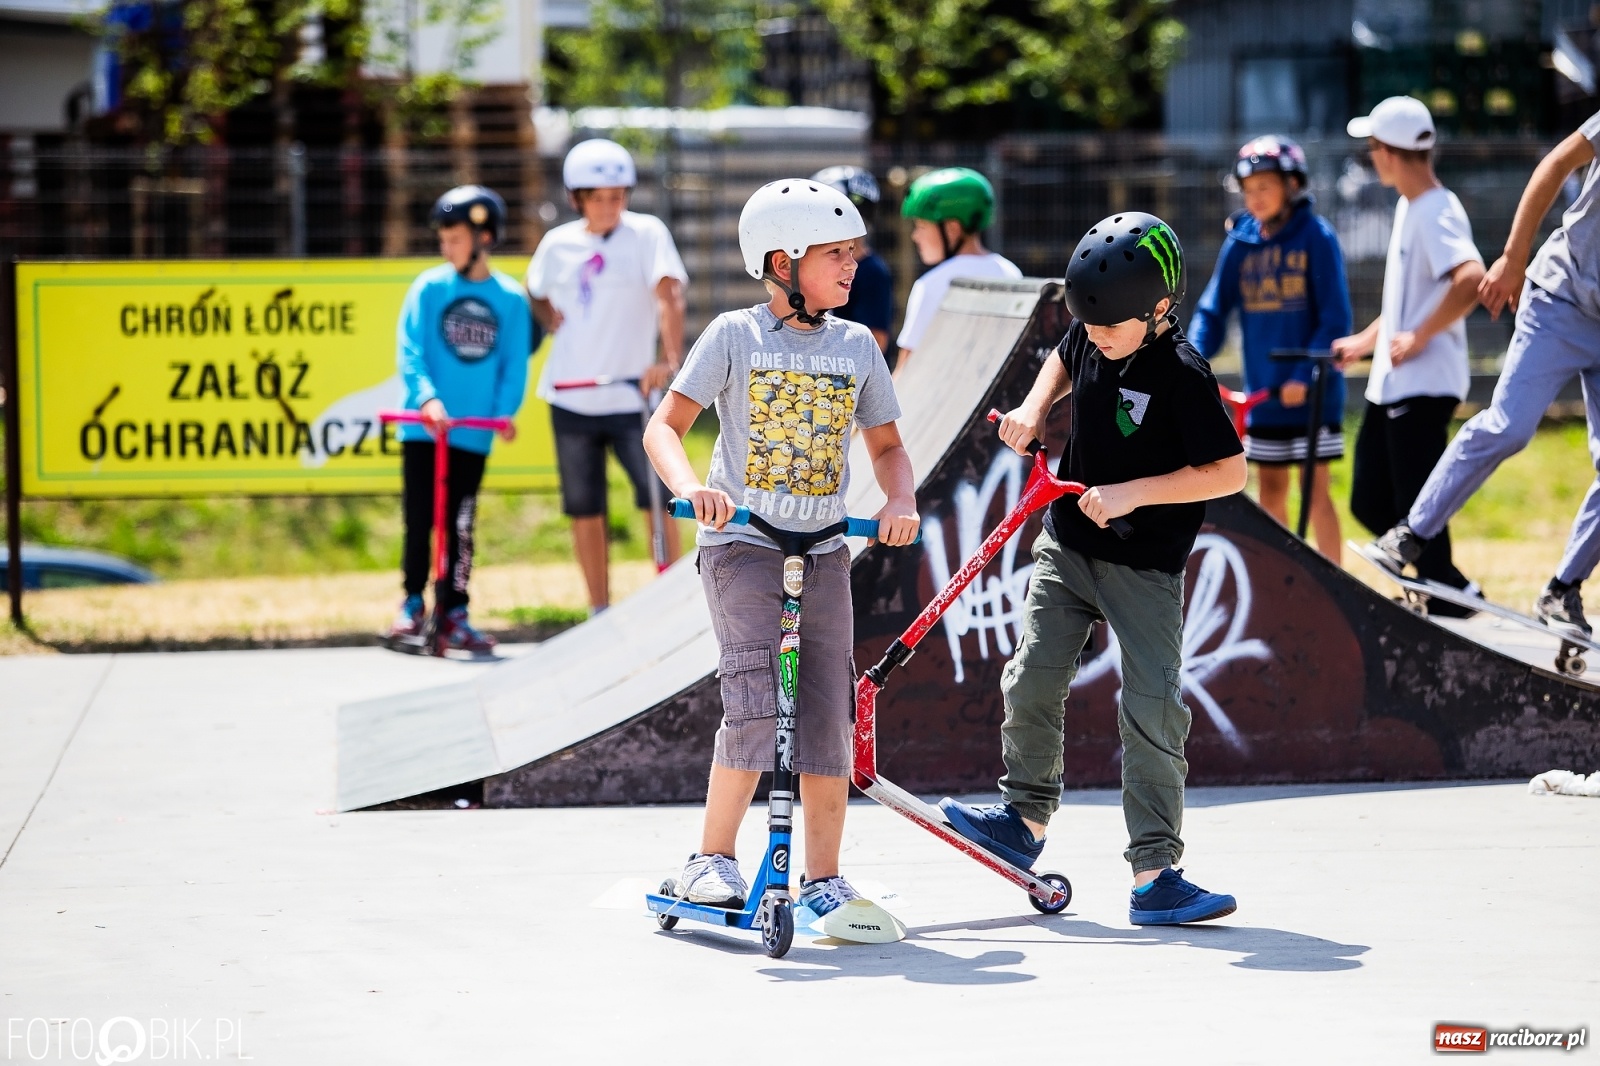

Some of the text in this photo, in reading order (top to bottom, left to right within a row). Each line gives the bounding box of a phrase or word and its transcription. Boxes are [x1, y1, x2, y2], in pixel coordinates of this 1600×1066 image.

[751, 352, 856, 374] ONE IS NEVER
[742, 488, 840, 521] ENOUGH
